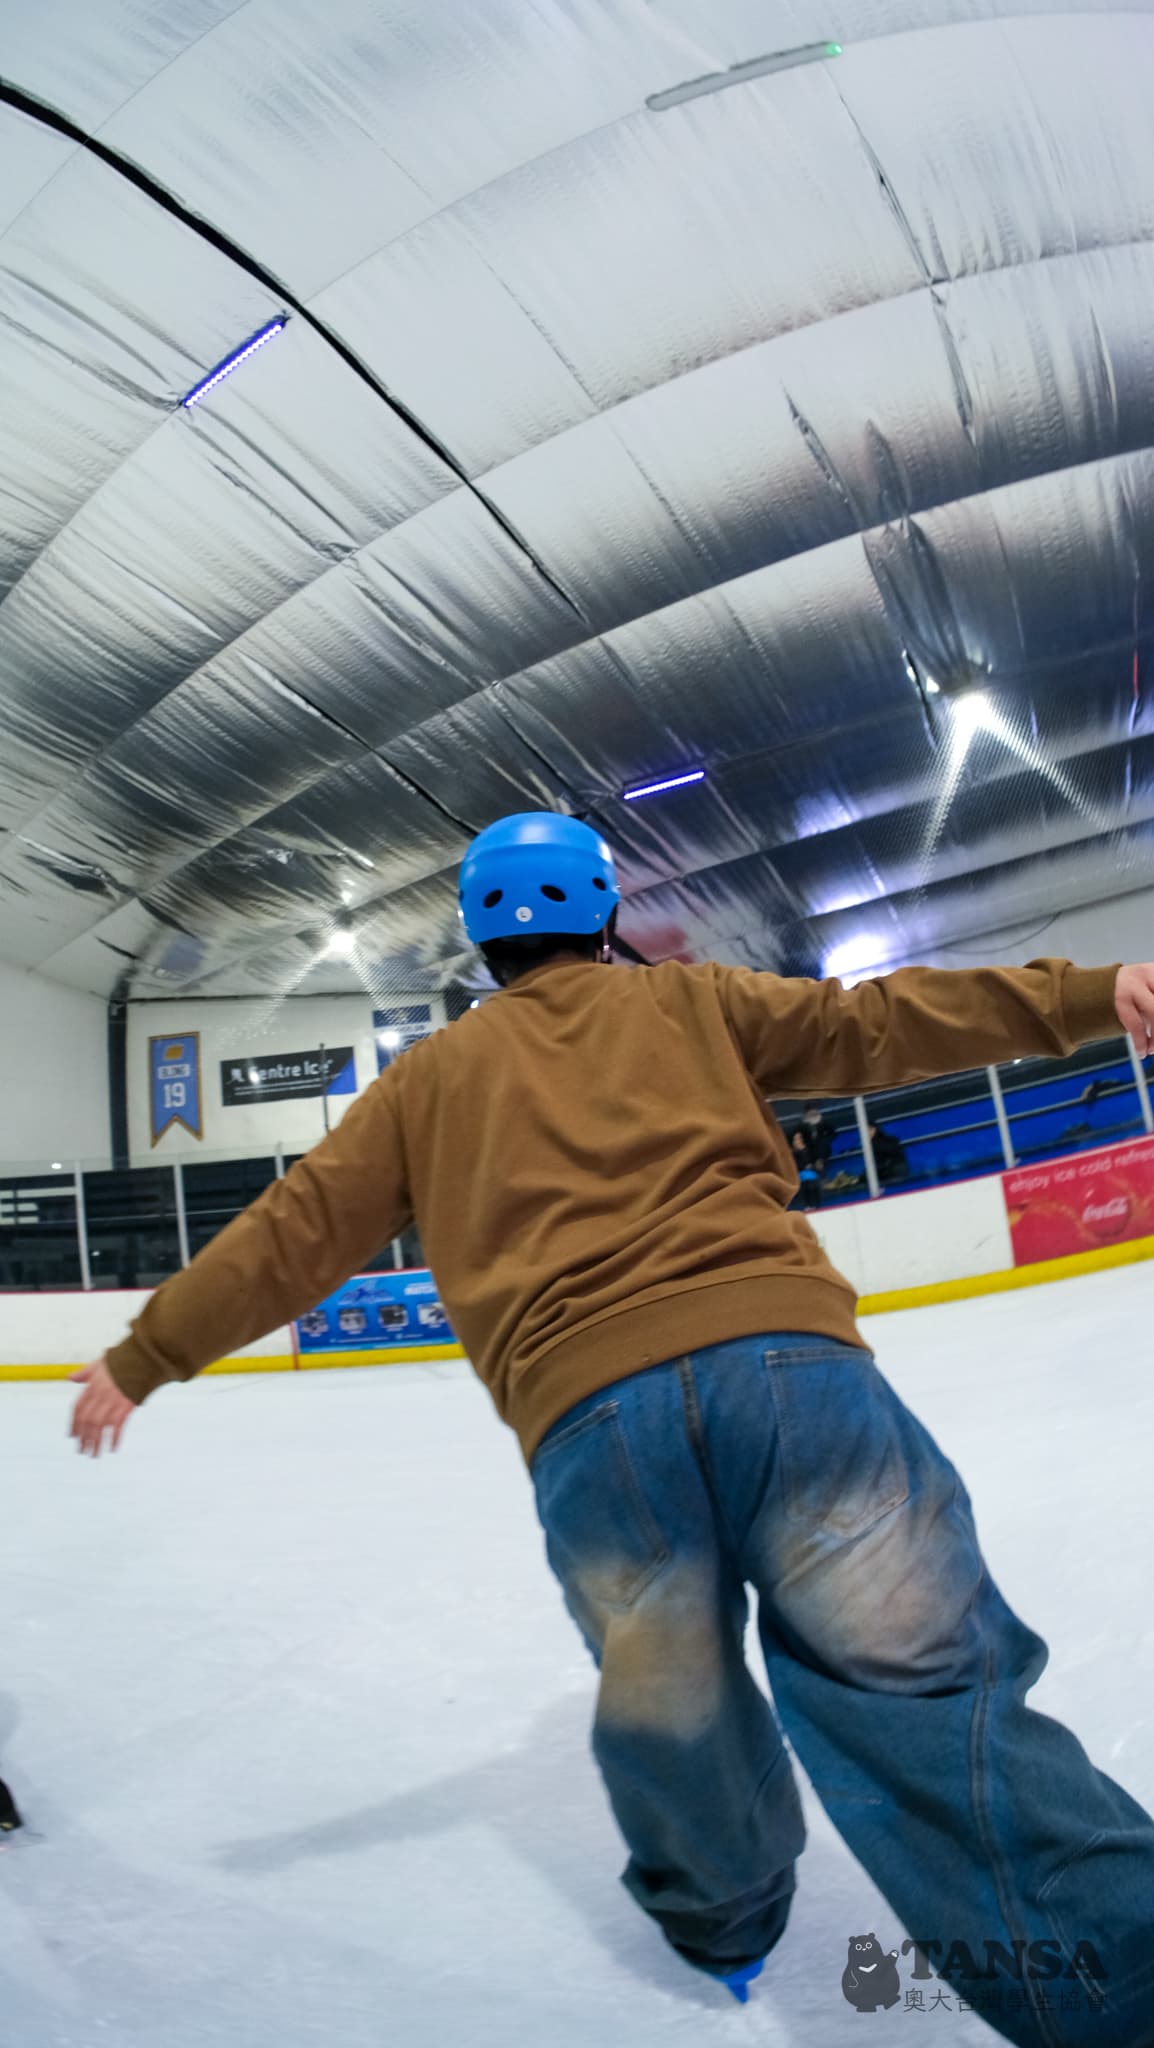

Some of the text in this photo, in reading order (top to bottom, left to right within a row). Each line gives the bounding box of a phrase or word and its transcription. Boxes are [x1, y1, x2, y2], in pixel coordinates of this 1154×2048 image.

[163, 1082, 186, 1108] 19
[1009, 1173, 1049, 1193] enjoy
[1054, 1167, 1075, 1183] ice
[1079, 1157, 1112, 1177] cold
